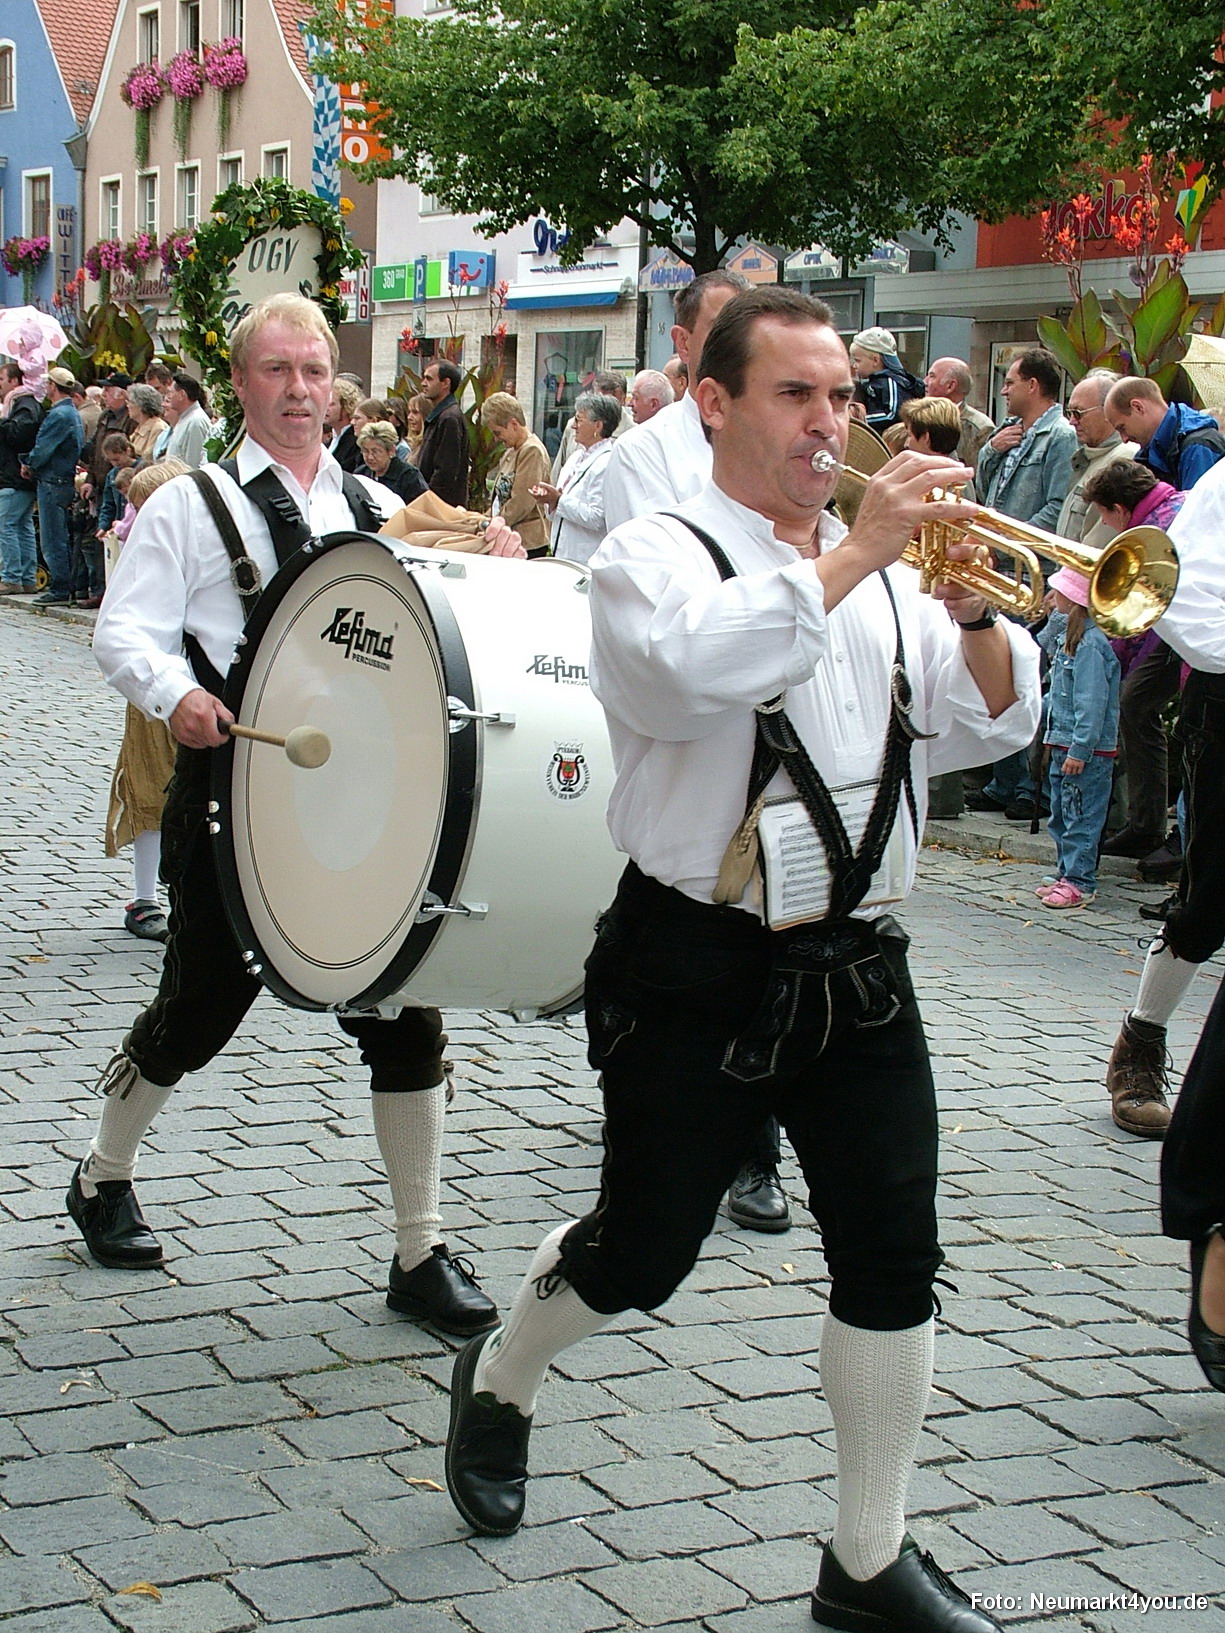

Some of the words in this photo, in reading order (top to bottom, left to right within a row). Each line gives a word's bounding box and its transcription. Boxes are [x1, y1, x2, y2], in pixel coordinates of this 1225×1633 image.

[248, 237, 300, 275] OGV
[382, 270, 395, 290] 360
[352, 652, 392, 673] PERCUSSION
[526, 654, 589, 684] Lefim
